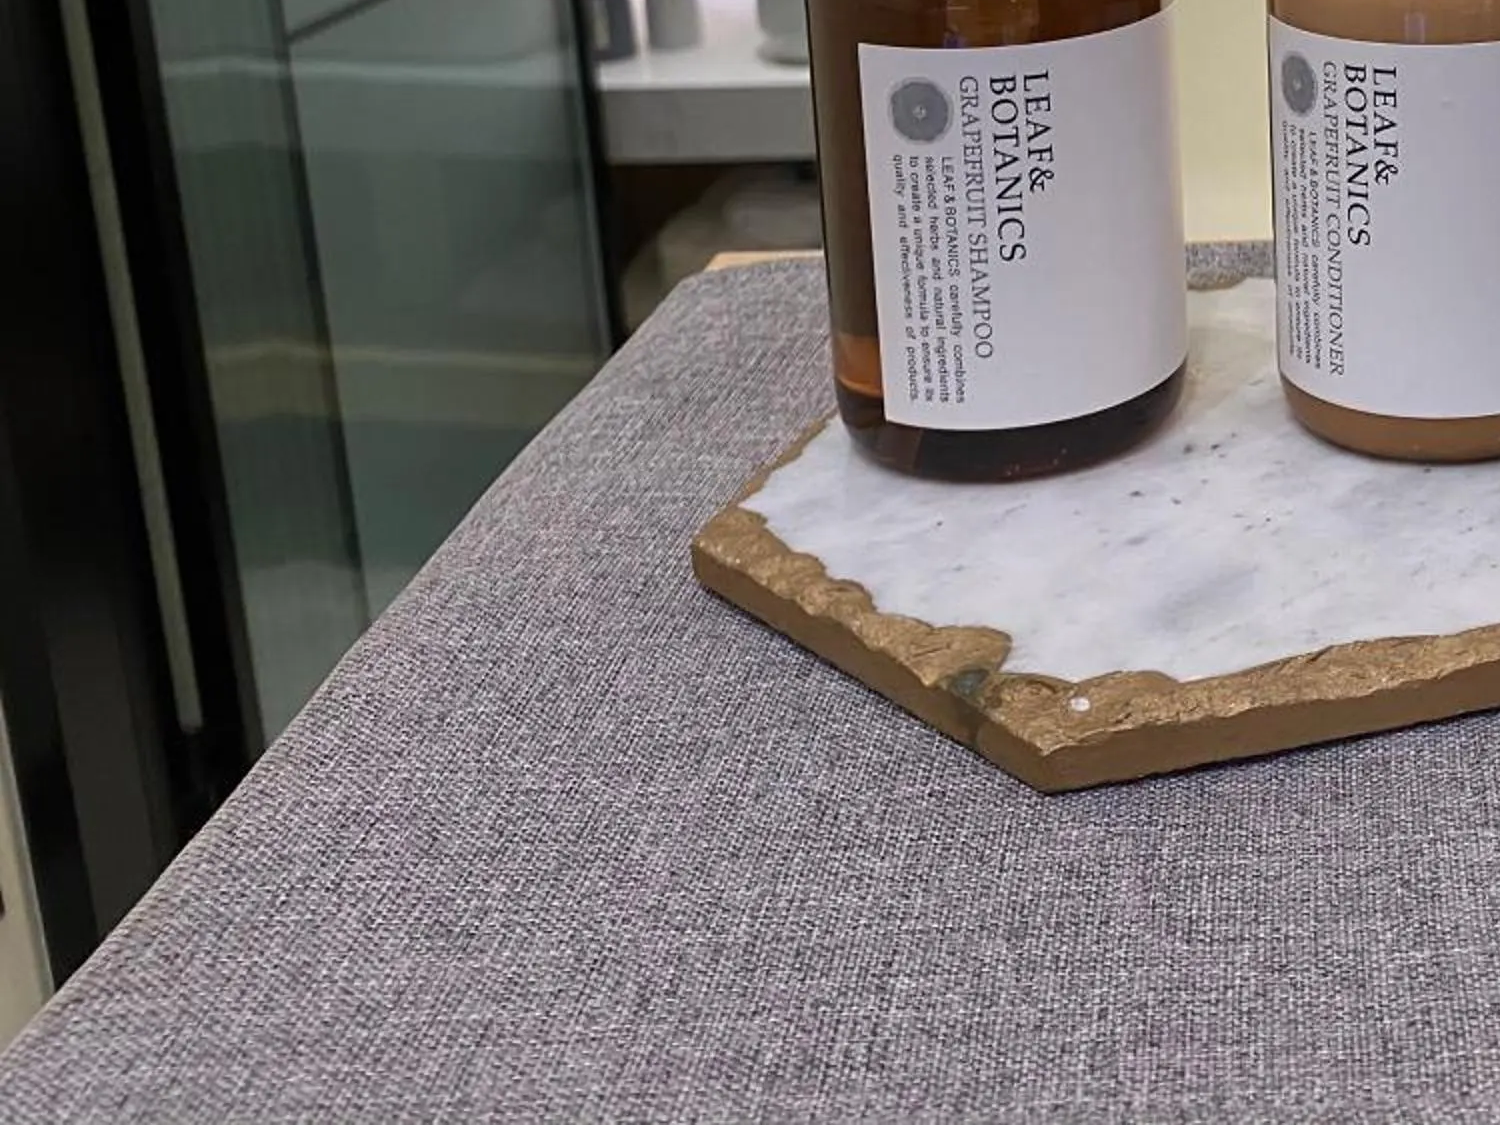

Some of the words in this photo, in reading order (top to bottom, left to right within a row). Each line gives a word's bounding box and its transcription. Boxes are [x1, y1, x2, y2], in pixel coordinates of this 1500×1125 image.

[959, 76, 987, 227] GRAPEFRUIT
[1023, 72, 1055, 193] LEAF&
[1323, 61, 1340, 209] GRAPEFRUIT
[1373, 66, 1399, 185] LEAF&
[893, 155, 905, 197] quality
[910, 156, 919, 167] to
[942, 156, 955, 191] LEAF
[989, 76, 1026, 262] BOTANICS
[1344, 63, 1370, 245] BOTANICS
[910, 173, 921, 211] create
[925, 156, 939, 209] selected
[898, 205, 908, 228] and
[929, 217, 939, 251] herbs
[945, 206, 960, 277] BOTANICS
[932, 258, 944, 280] and
[1327, 213, 1344, 376] CONDITIONER
[934, 287, 946, 329] natural
[950, 285, 963, 336] carefully
[968, 234, 994, 358] SHAMPOO
[905, 327, 916, 339] of
[921, 326, 930, 337] to
[935, 337, 949, 402] ingredients
[954, 345, 966, 403] combines
